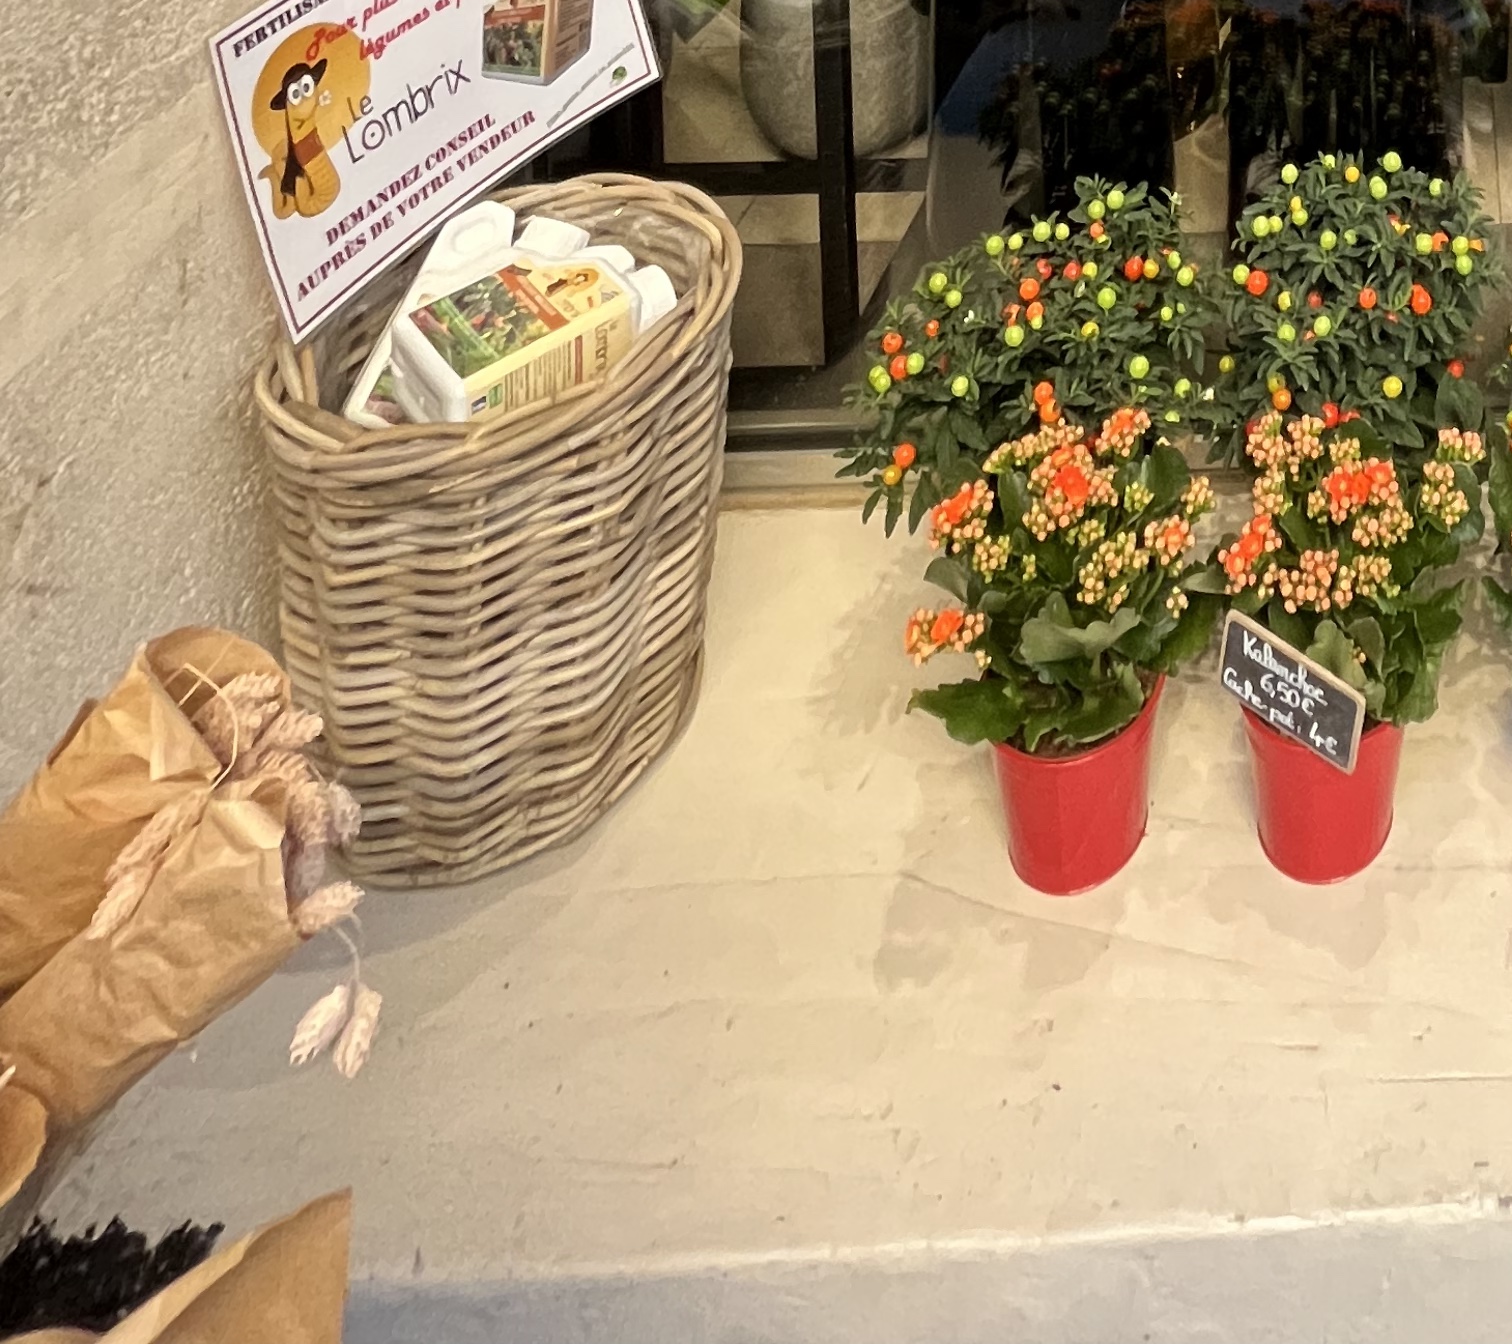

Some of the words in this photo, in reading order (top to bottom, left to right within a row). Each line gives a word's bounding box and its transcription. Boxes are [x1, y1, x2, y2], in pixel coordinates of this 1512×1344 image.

[341, 59, 471, 164] Lombrix
[347, 95, 374, 122] Le
[297, 233, 367, 302] AUPRÈS
[370, 211, 395, 241] DE
[396, 166, 454, 217] VOTRE
[456, 110, 536, 172] VENDEUR
[325, 164, 423, 246] DEMANDEZ
[425, 113, 497, 172] CONSEIL
